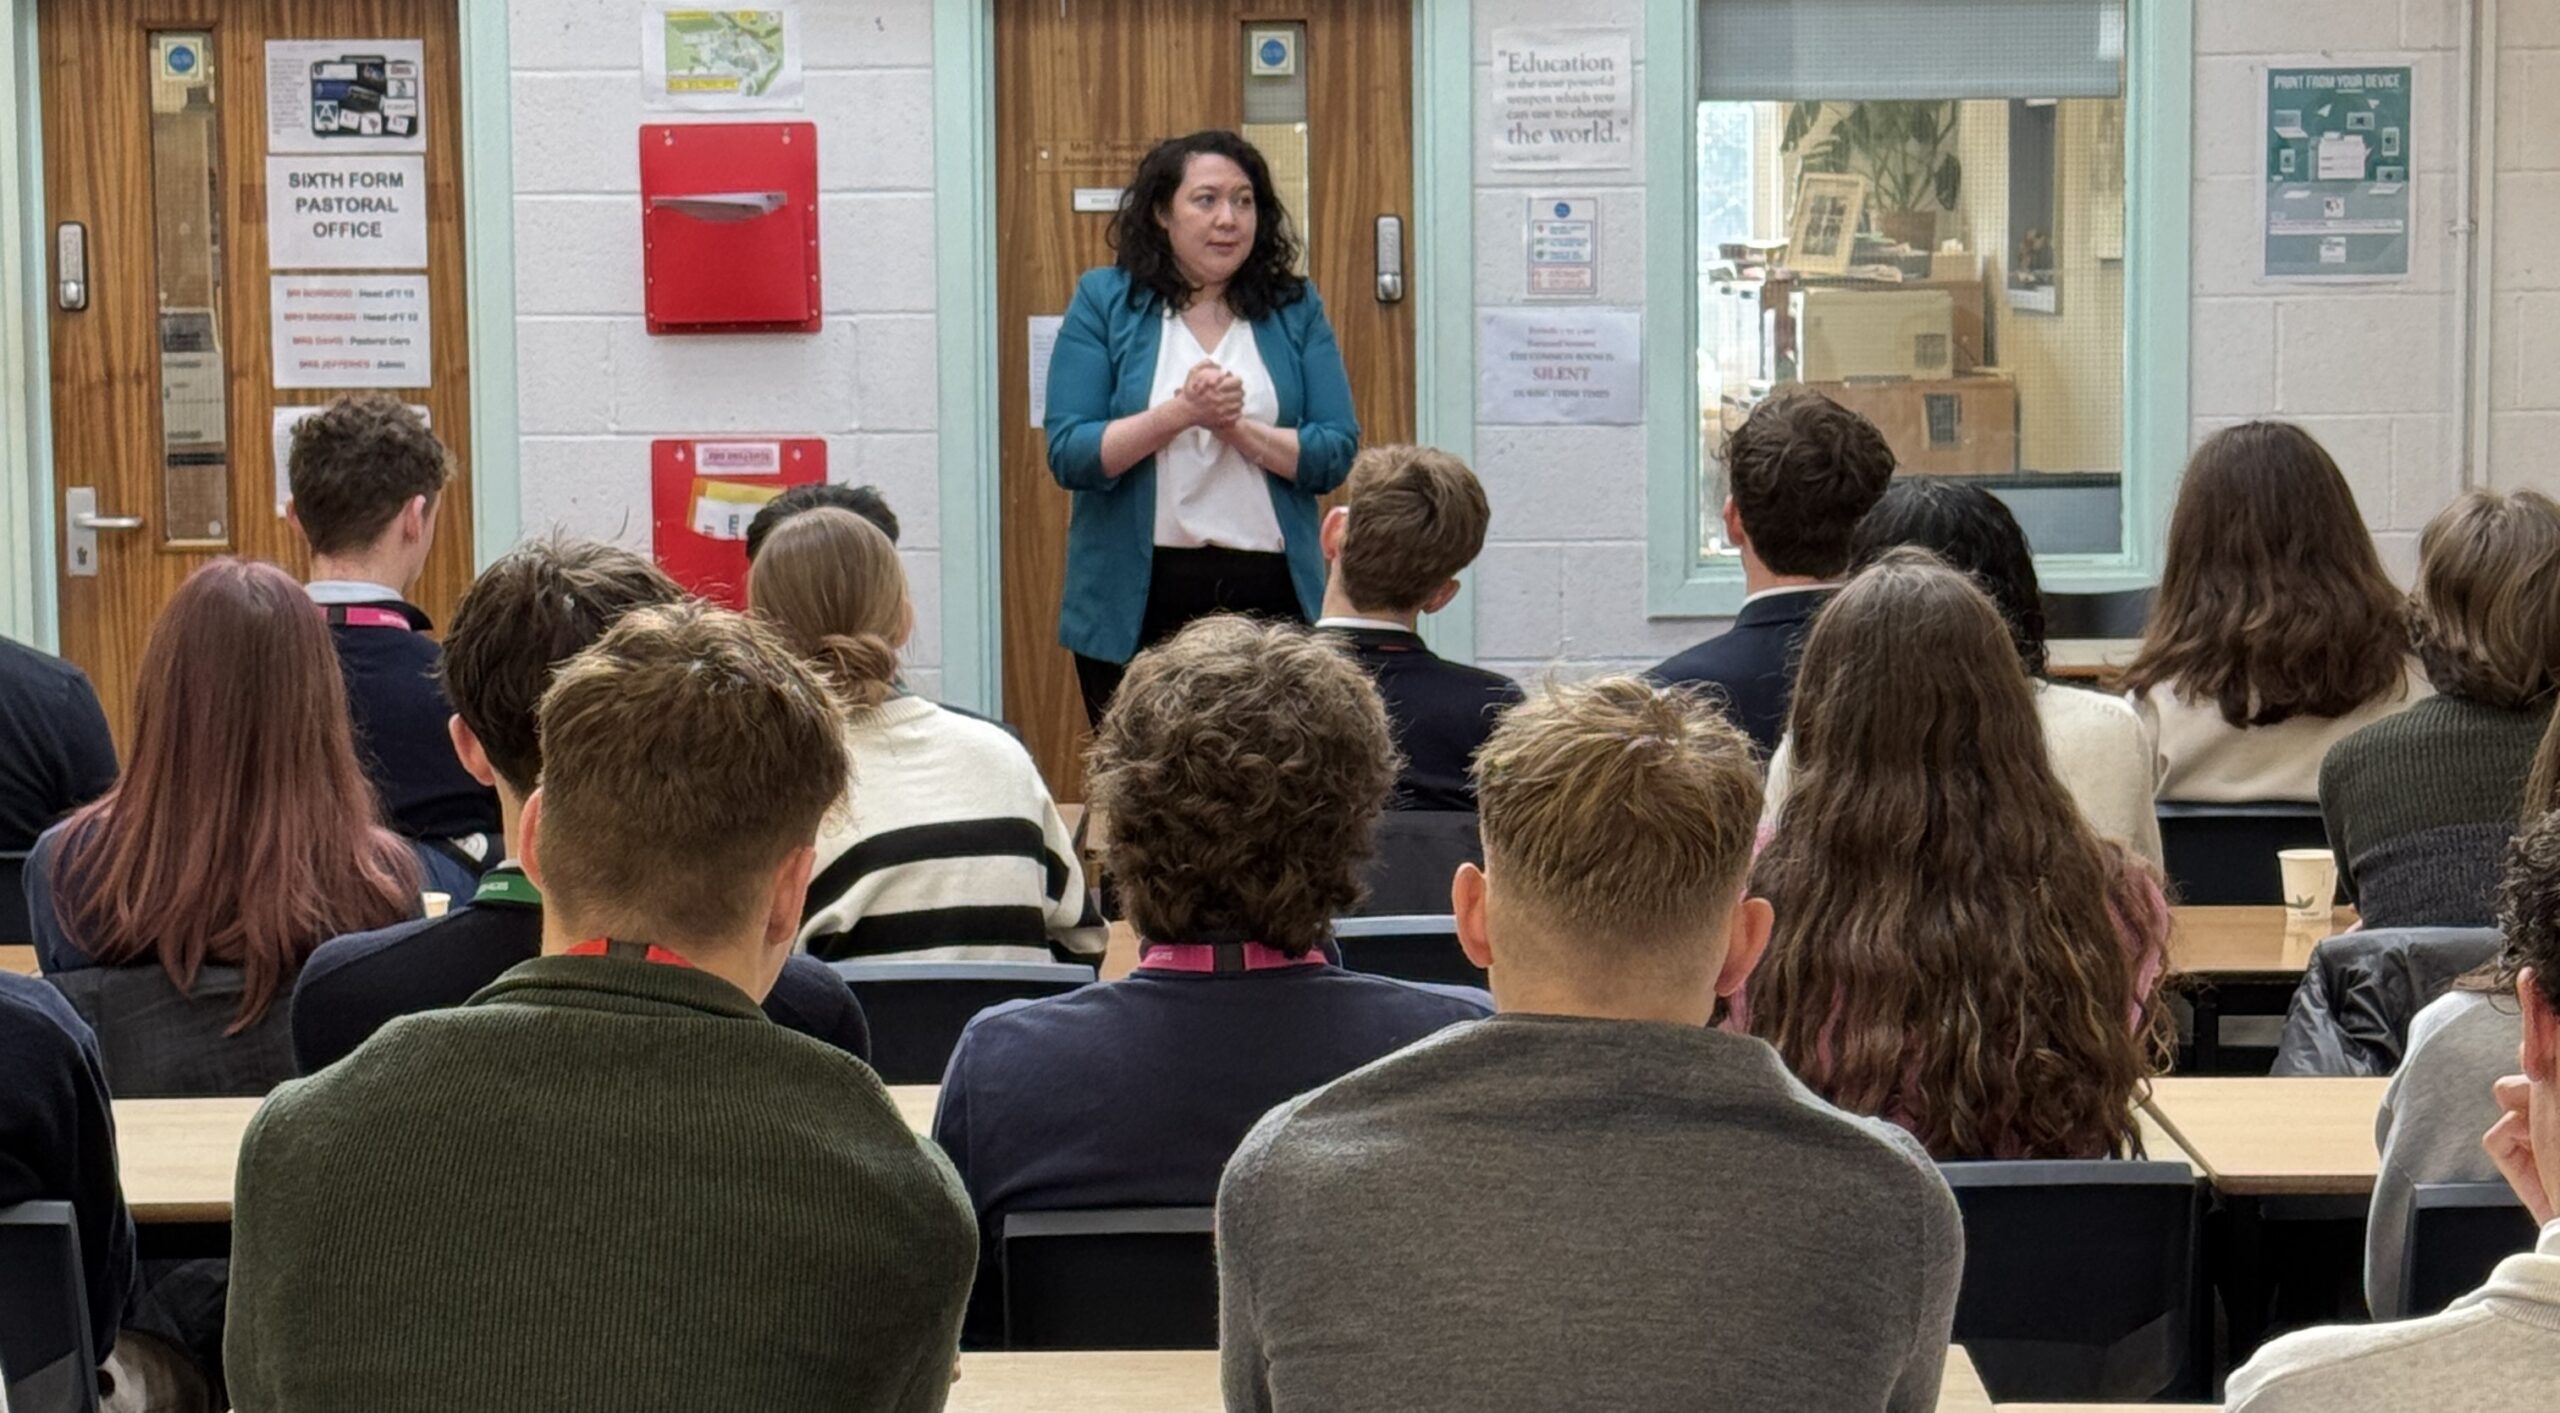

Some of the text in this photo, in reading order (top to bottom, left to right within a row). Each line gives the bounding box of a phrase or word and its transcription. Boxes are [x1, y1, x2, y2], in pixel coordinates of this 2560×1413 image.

[2274, 73, 2400, 89] PRINT FROM YOUR DEVICE
[1506, 95, 1552, 106] weapon
[1555, 92, 1591, 103] which
[1506, 111, 1529, 120] can
[1570, 106, 1614, 120] change
[1507, 122, 1543, 144] the
[289, 172, 403, 188] SIXTH FORM
[295, 197, 399, 213] PASTORAL
[313, 221, 383, 238] OFFICE
[359, 288, 383, 298] Head
[363, 312, 387, 321] Head
[350, 336, 387, 345] Pastoral
[389, 336, 411, 345] Care
[1532, 366, 1591, 381] SILENT
